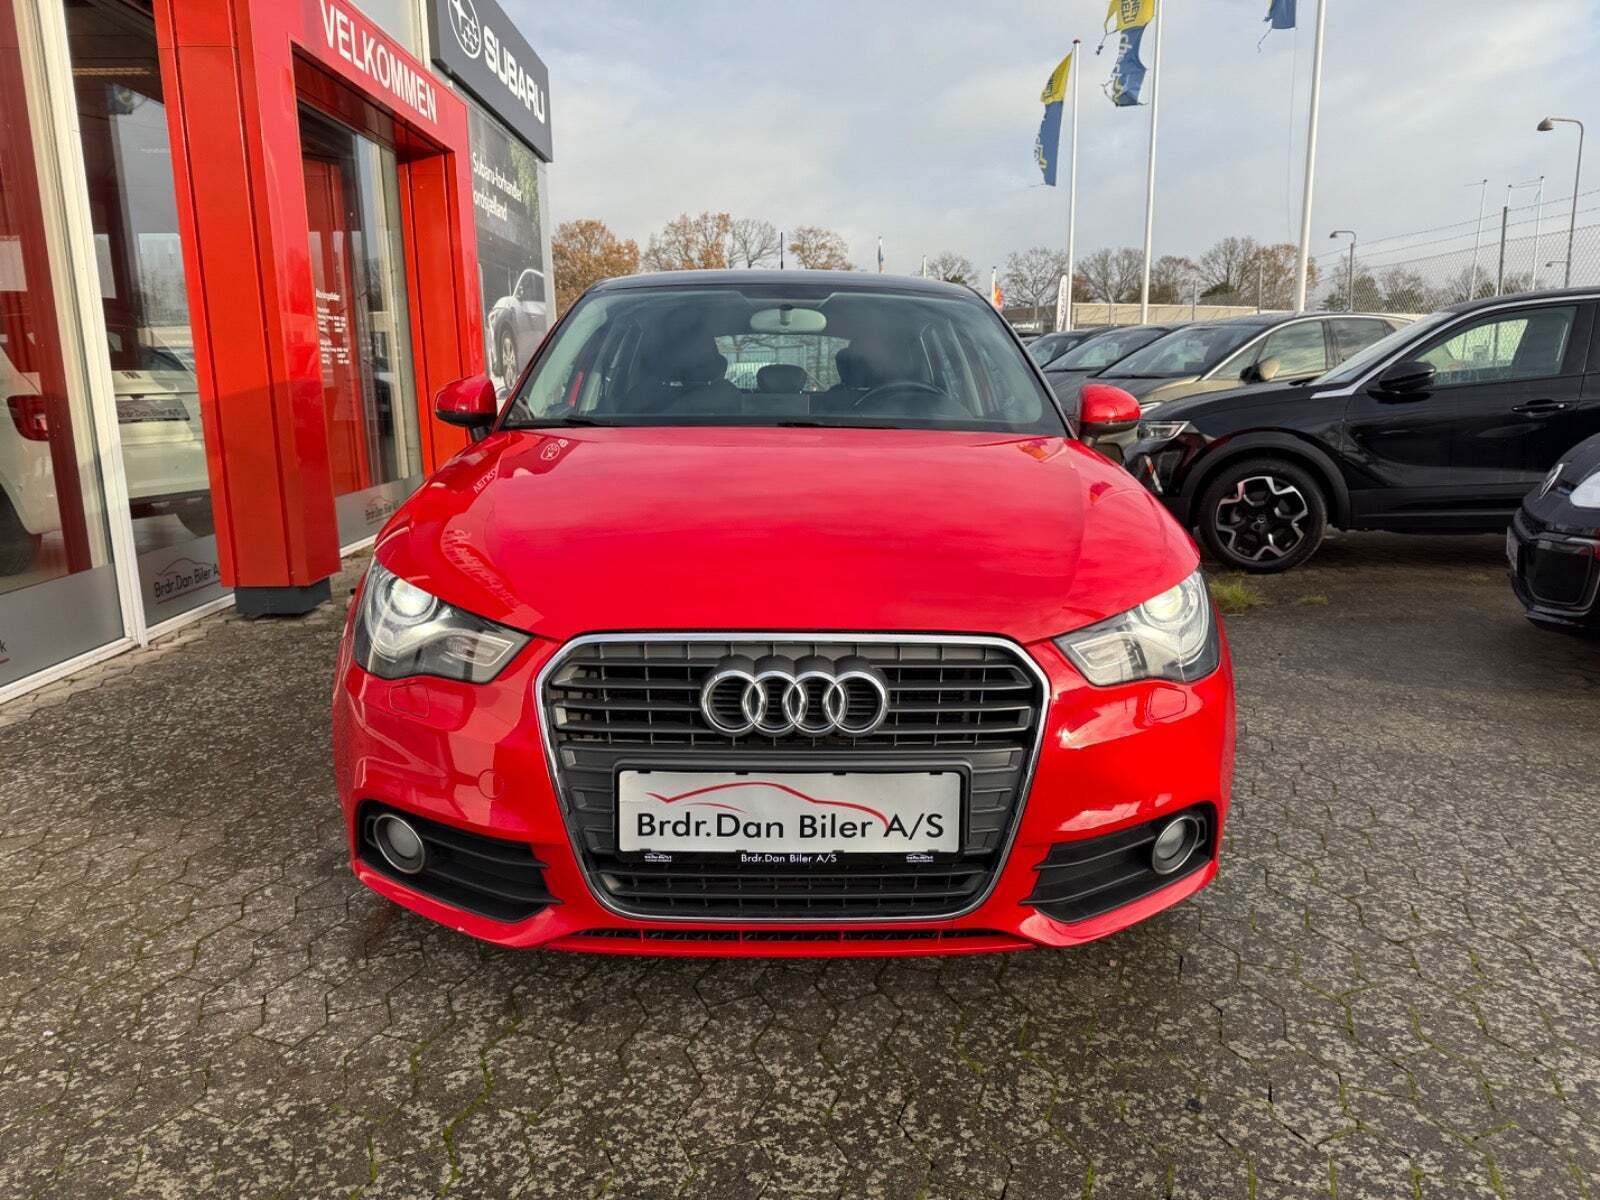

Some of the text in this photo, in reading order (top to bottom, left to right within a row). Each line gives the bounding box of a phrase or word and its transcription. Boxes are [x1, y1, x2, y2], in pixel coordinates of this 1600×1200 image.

[320, 0, 438, 125] VELKOMMEN
[483, 25, 545, 125] SUBARU
[636, 811, 944, 840] Brdr.Dan Biler A/S
[740, 853, 837, 864] Brdr.Dan Biler A/S
